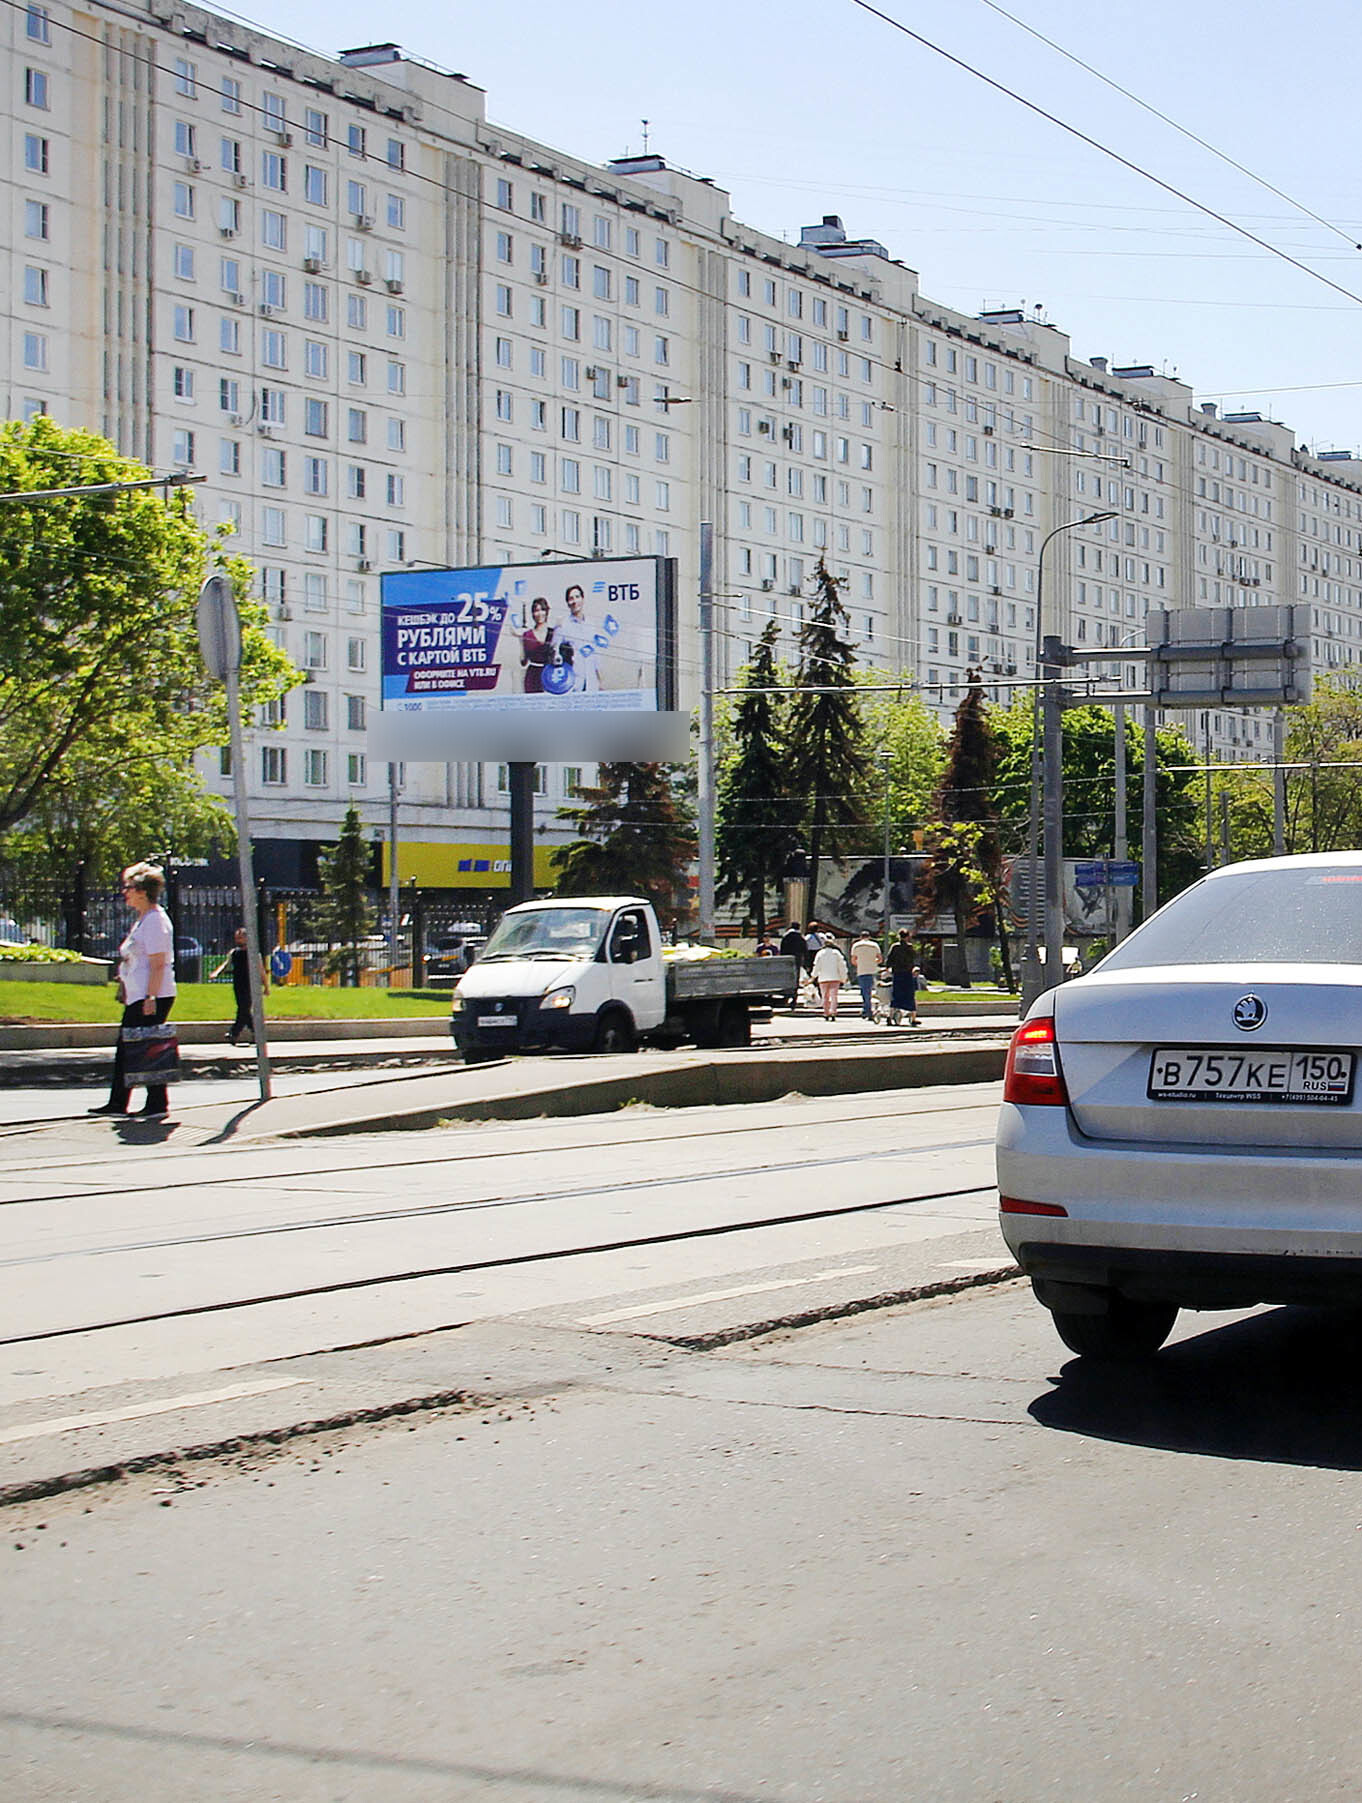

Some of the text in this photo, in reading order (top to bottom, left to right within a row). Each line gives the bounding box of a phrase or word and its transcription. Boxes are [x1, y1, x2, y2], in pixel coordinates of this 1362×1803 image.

[608, 584, 640, 601] ВТБ
[398, 613, 438, 626] КЕШБЭК
[440, 612, 455, 625] ДО
[397, 625, 486, 648] РУБЛЯМИ
[397, 647, 487, 665] С КАРТОЙ ВТБ
[1163, 1055, 1287, 1088] В757КЕ
[1296, 1056, 1342, 1080] 150
[1303, 1081, 1327, 1091] RUS
